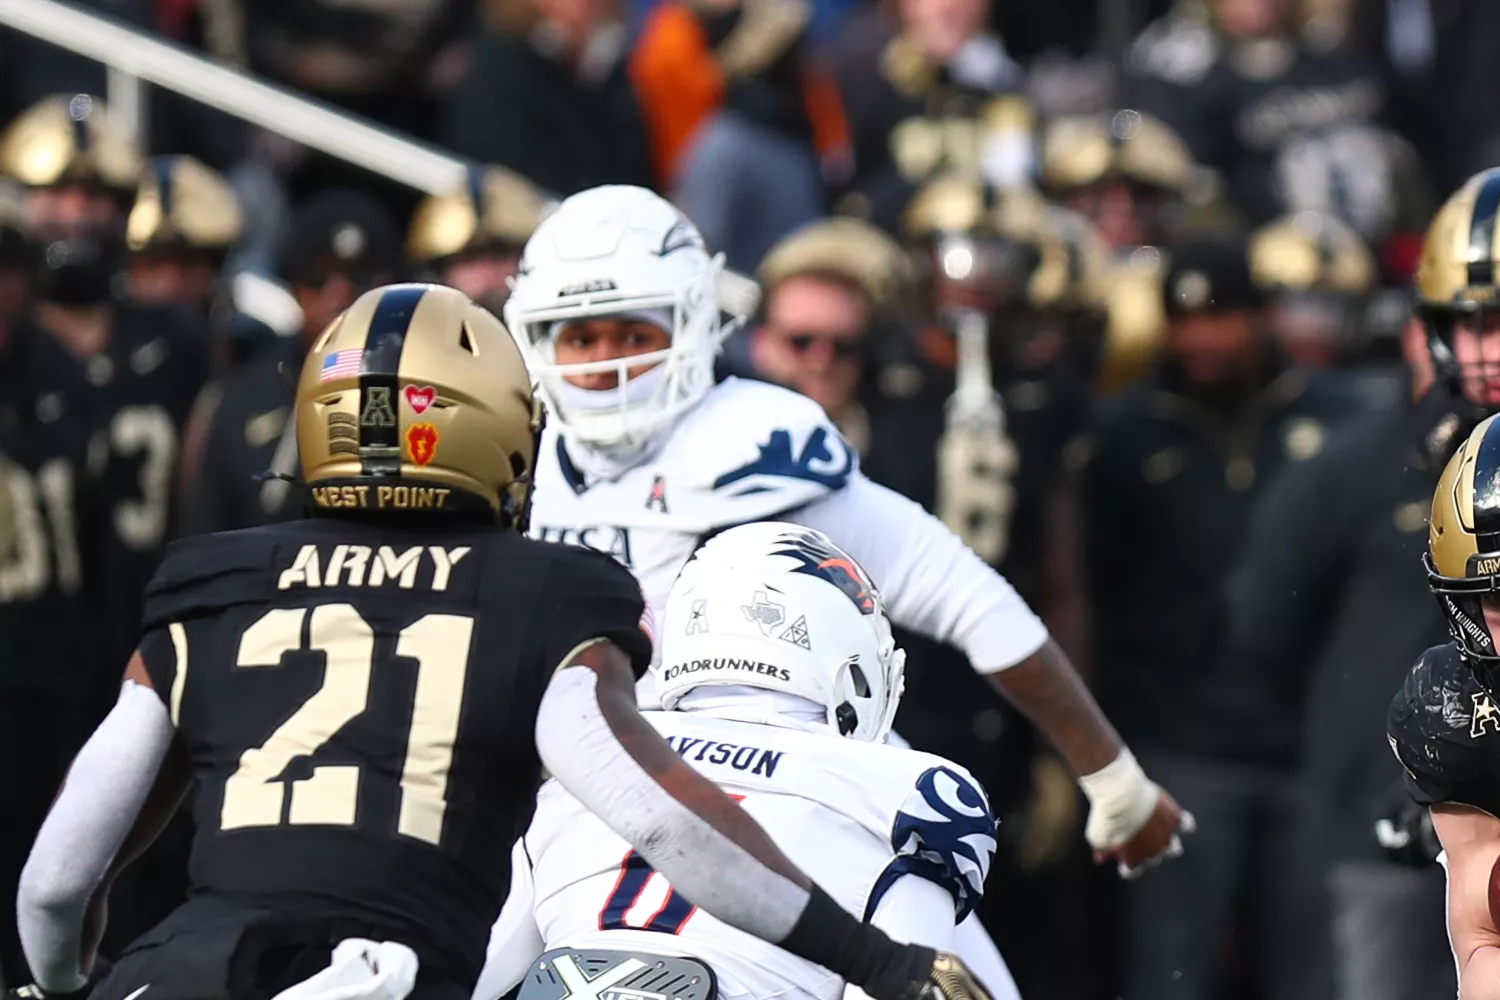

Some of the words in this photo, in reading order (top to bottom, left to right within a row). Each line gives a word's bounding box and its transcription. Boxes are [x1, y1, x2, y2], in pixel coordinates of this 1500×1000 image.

[312, 485, 370, 508] WEST
[377, 486, 451, 509] POINT
[277, 544, 472, 591] ARMY
[664, 658, 791, 682] ROADRUNNERS
[220, 603, 475, 846] 21
